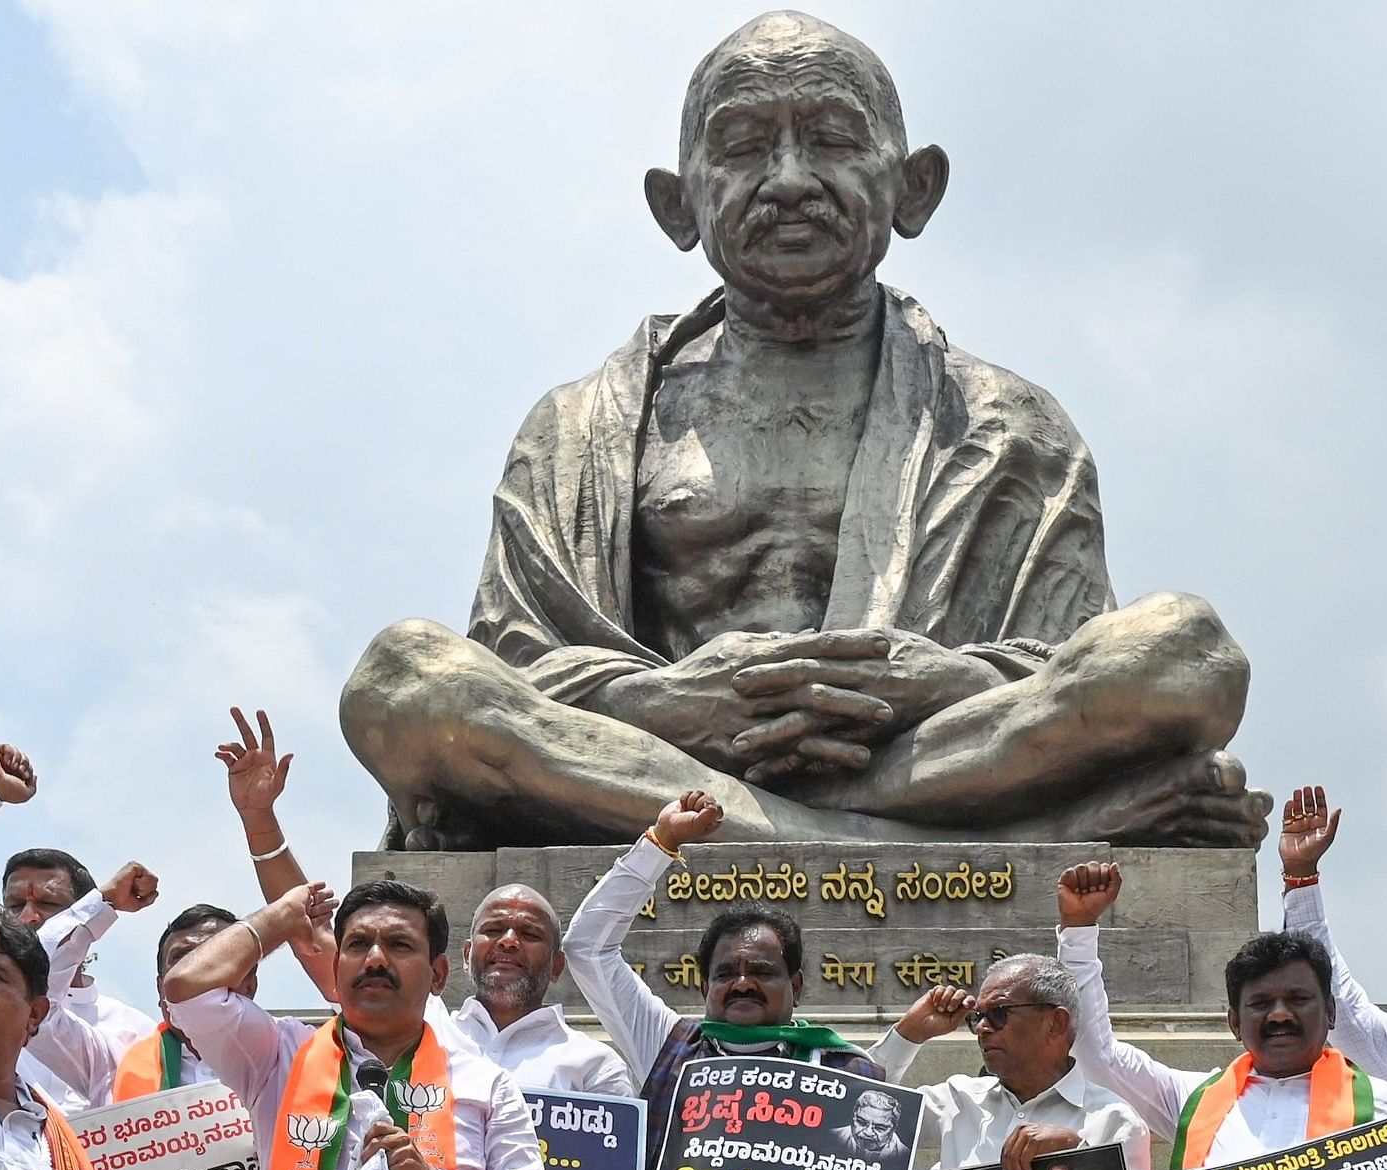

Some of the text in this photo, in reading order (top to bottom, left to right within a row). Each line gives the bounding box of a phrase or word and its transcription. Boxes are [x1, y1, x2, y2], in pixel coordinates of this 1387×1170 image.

[668, 863, 808, 901] ಜೀವನವೇ
[821, 862, 887, 918] ನನ್ನ
[897, 862, 1014, 900] ಸಂದೇಶ
[821, 953, 876, 988] मेरा
[895, 951, 974, 987] संदेश
[689, 1066, 848, 1100] ದೇಶ ಕಂಡ ಕಡು
[114, 1109, 181, 1143] ಭೂಮಿ
[187, 1093, 246, 1121] ನುಂಗಿ
[550, 1101, 617, 1148] ದುಡ್ಡು
[681, 1088, 823, 1133] ಭ್ರಷ್ಟ ಸಿಎಂ
